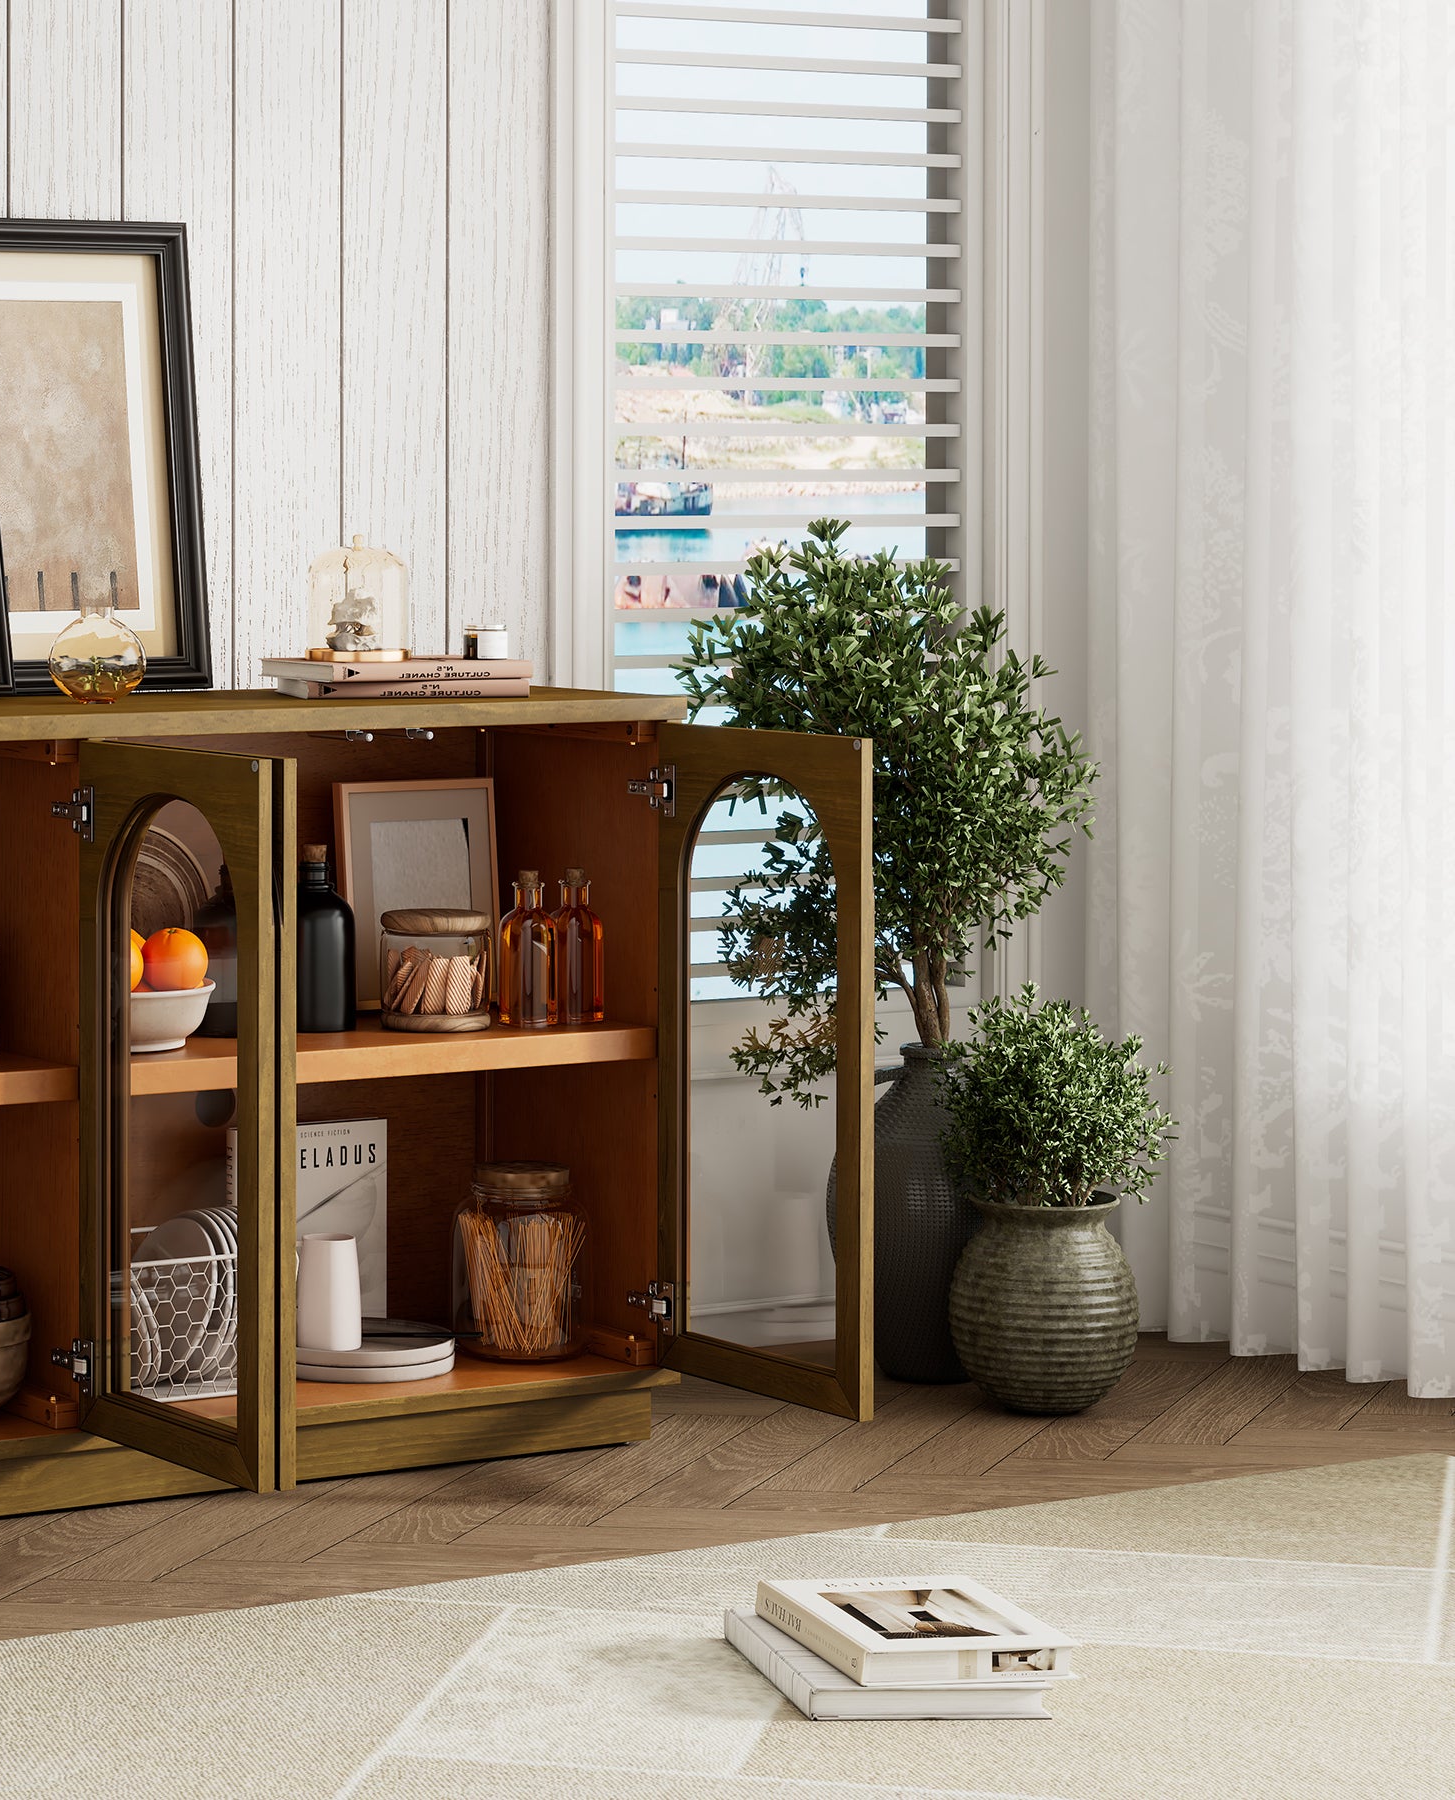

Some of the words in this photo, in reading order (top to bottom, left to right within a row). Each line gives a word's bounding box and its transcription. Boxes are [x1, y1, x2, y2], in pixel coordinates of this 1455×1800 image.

[300, 1130, 324, 1138] SCIENCE
[327, 1128, 351, 1137] FICTION
[300, 1143, 376, 1169] ELADUS
